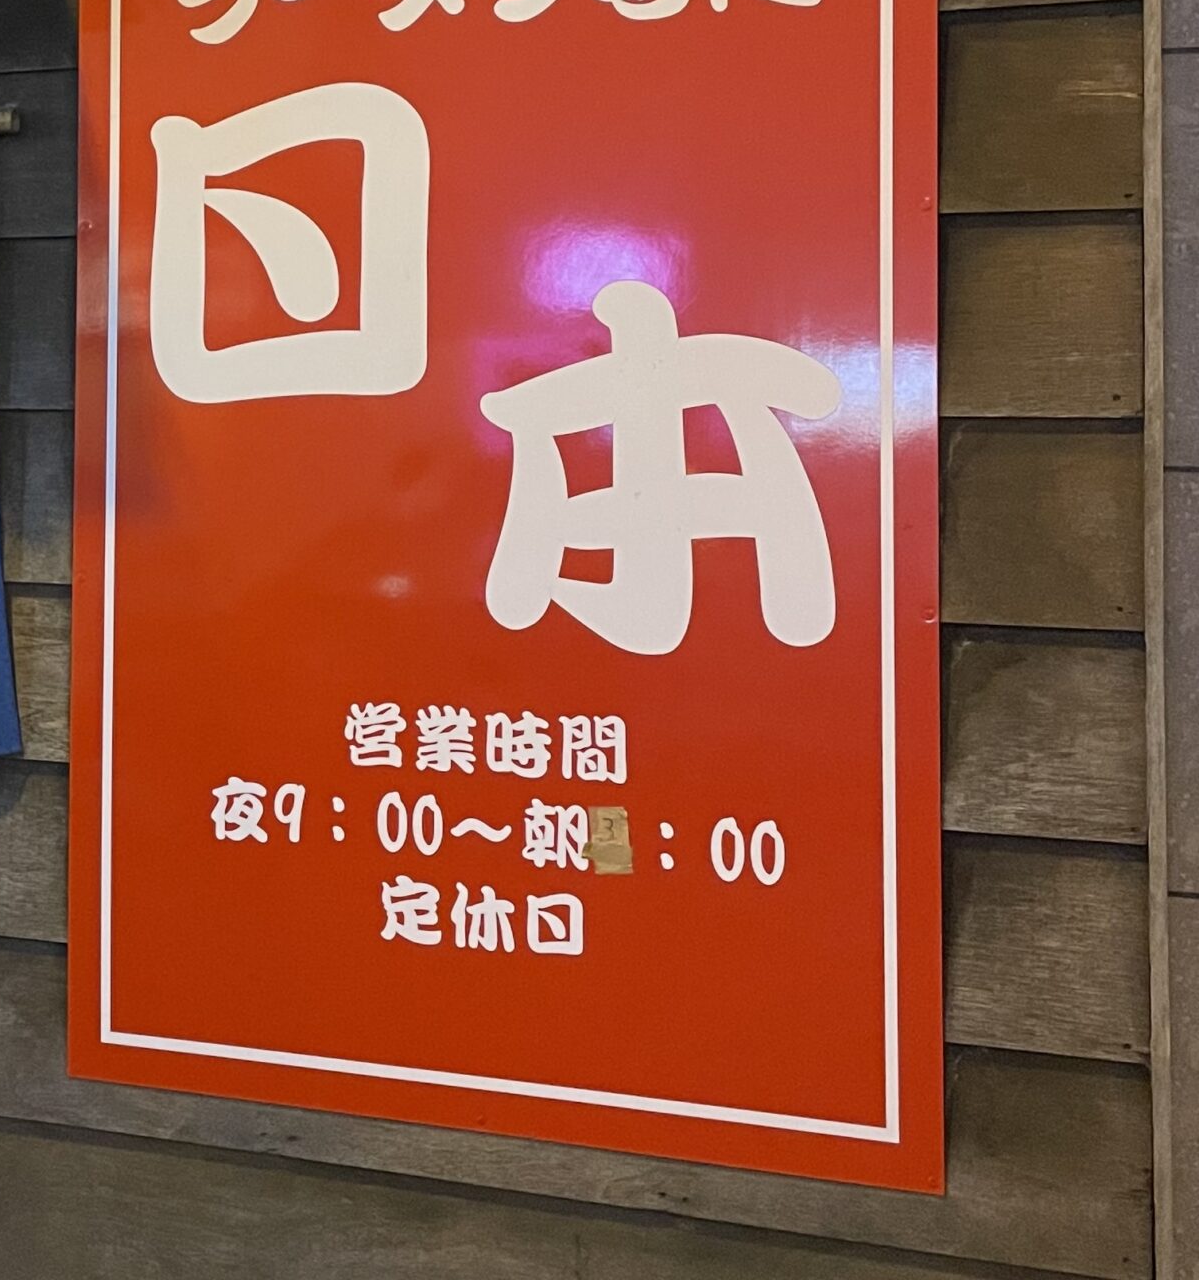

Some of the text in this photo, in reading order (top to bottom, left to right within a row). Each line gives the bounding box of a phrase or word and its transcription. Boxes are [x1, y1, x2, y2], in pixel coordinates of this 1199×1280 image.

[150, 82, 841, 656] 日本
[344, 702, 628, 785] 営業時間
[380, 875, 585, 956] 定休日
